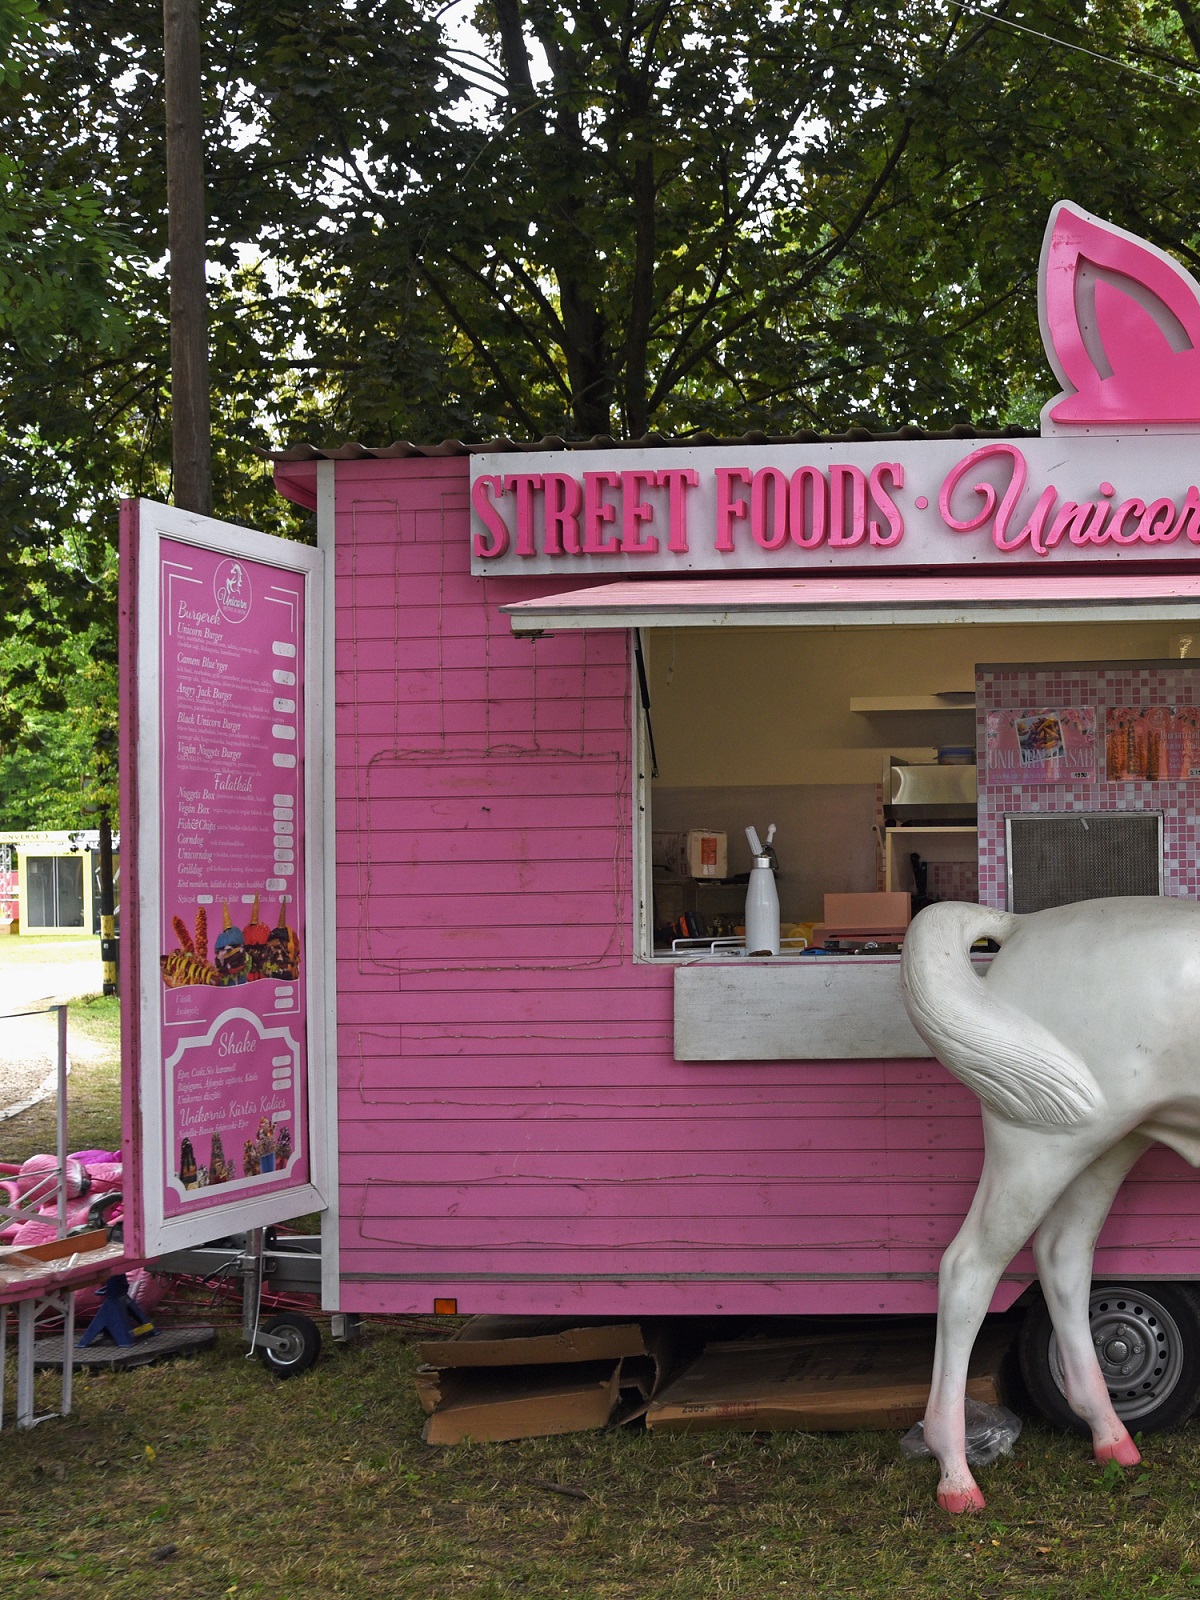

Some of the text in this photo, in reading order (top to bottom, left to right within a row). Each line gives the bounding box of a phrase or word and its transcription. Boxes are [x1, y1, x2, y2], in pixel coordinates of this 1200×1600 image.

[471, 462, 904, 559] STREET FOODS
[217, 587, 248, 609] Unicorn
[179, 600, 221, 626] Burgerek
[177, 622, 224, 642] Unicorn Burger
[177, 652, 200, 666] Camem
[176, 682, 195, 696] Angry
[196, 685, 211, 698] Jack
[213, 688, 232, 702] Burger
[177, 712, 195, 724] Black
[197, 715, 221, 728] Unicorn
[222, 718, 241, 732] Burger
[197, 744, 220, 759] Nuggets
[221, 747, 242, 761] Burger
[988, 749, 1045, 769] UNICORN
[215, 773, 253, 793] Falatkák
[177, 787, 201, 801] Nuggets
[202, 789, 216, 800] Box
[197, 803, 210, 814] Box
[177, 818, 216, 833] Fish&Chips
[177, 833, 204, 848] Corndog
[177, 848, 212, 863] Unicorndog
[177, 863, 202, 877] Grilldog
[218, 1031, 256, 1056] Shake
[180, 1106, 226, 1126] Unikornis
